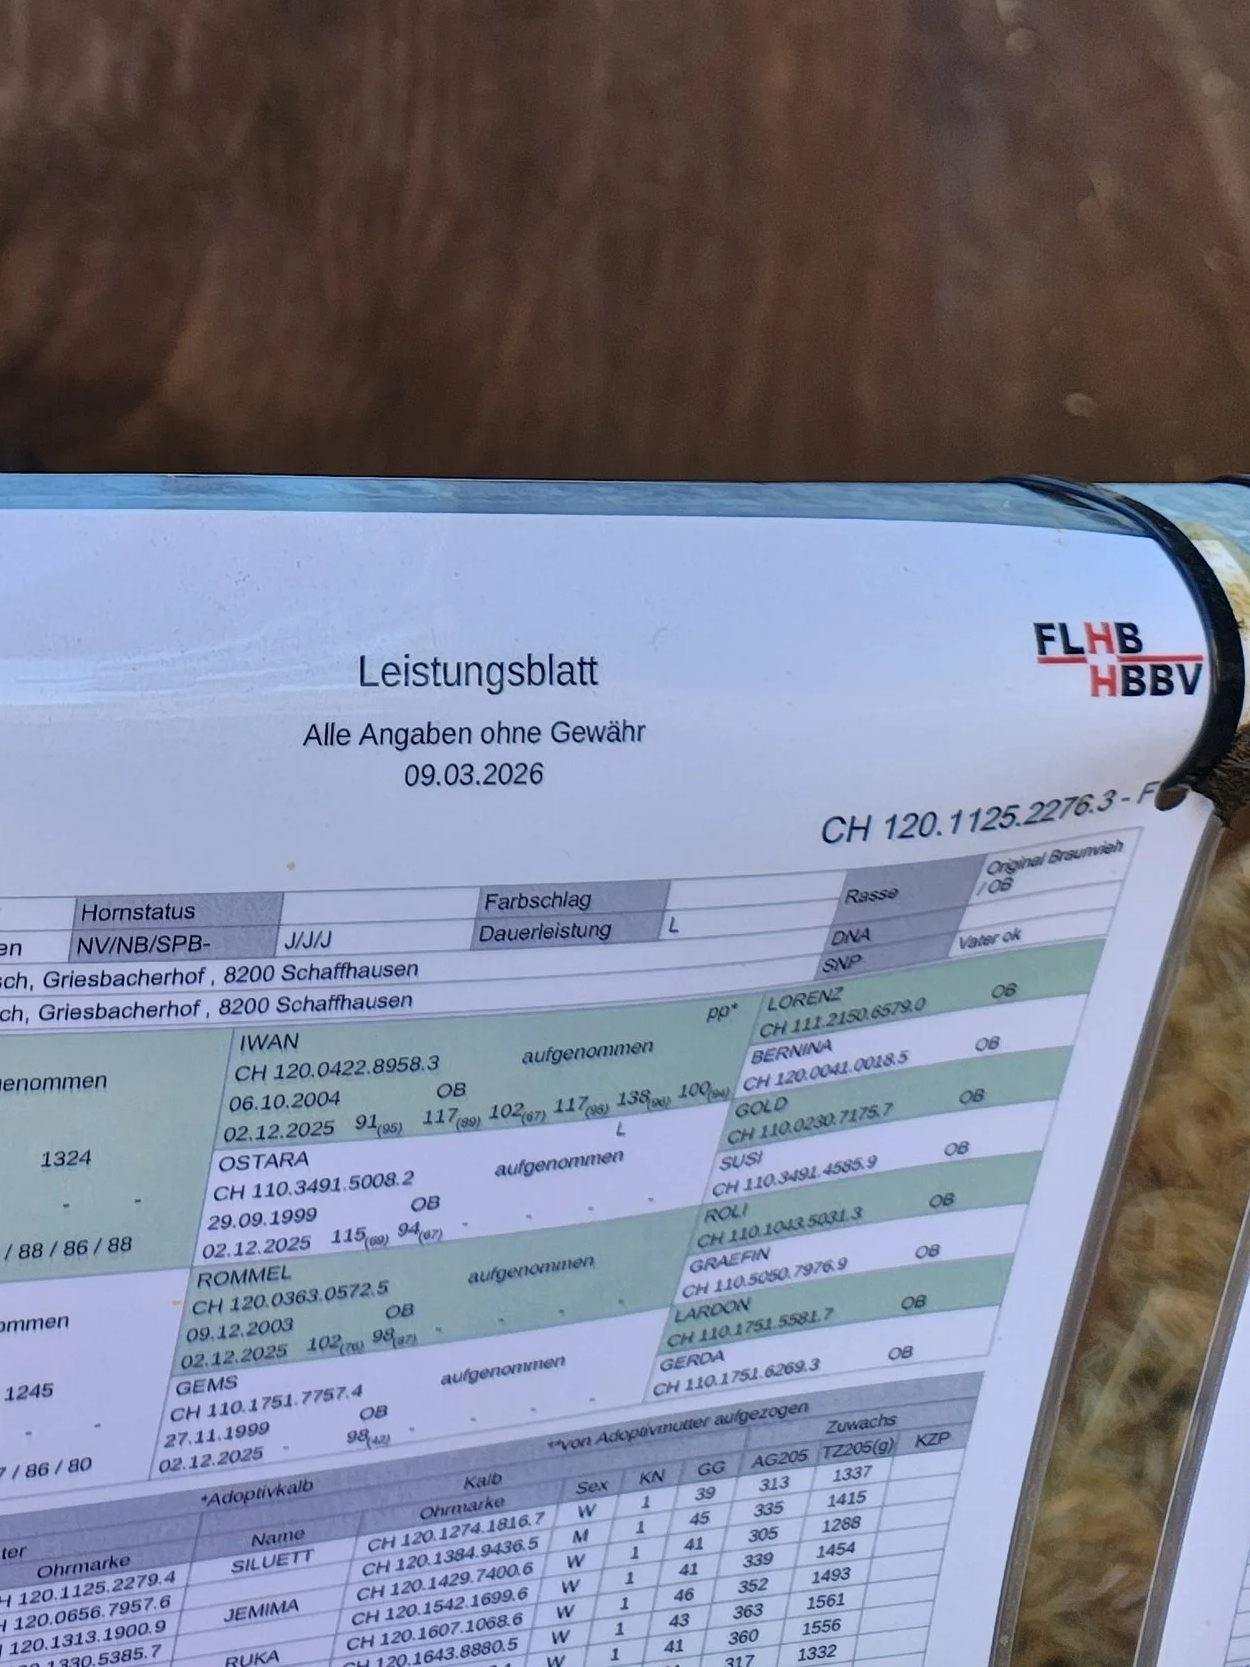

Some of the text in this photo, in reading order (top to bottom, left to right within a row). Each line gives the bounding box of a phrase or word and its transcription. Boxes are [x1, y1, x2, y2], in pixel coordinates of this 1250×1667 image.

[1033, 622, 1144, 656] FLHB
[359, 654, 598, 694] Leistungsblatt
[1090, 664, 1203, 697] HBBV
[303, 719, 646, 750] Alle Angaben ohne Gewähr
[405, 762, 543, 787] 09.03.2026
[822, 816, 869, 844] CH
[885, 789, 1116, 839] 120.1125.2276.3
[986, 840, 1124, 876] Original Braunvieh
[845, 887, 898, 904] Rasse
[988, 877, 1014, 894] OB
[82, 903, 195, 922] Hornstatus
[485, 892, 592, 914] Farbschlag
[479, 921, 613, 942] Dauerleistung
[669, 917, 678, 934] L
[77, 935, 210, 956] NV/NB/SPB-
[284, 932, 332, 951] J/J/J
[831, 928, 870, 947] DNA
[959, 927, 1021, 950] Vater ok
[43, 967, 205, 988] Griesbacherhof
[224, 965, 274, 984] 8200
[281, 961, 418, 981] Schaffhausen
[823, 954, 862, 973] SNP
[767, 986, 845, 1011] LORENZ
[991, 983, 1018, 999] OB
[39, 1000, 200, 1020] Griesbacherhof
[219, 997, 269, 1015] 8200
[276, 992, 413, 1013] Schaffhausen
[240, 1033, 299, 1051] IWAN
[522, 1038, 653, 1066] aufgenommen
[750, 1038, 832, 1064] BERNINA
[974, 1037, 1001, 1052] OB
[235, 1056, 440, 1082] CH 120.0422.8958.3
[437, 1082, 467, 1099] OB
[742, 1075, 771, 1092] CH
[229, 1092, 340, 1112] 06.10.2004
[735, 1097, 789, 1119] GOLD
[224, 1121, 335, 1143] 02.12.2025
[41, 1150, 91, 1168] 1324
[219, 1151, 309, 1172] OSTARA
[495, 1148, 624, 1177] aufgenommen
[719, 1151, 763, 1171] SUSI
[213, 1170, 415, 1202] CH 110.3491.5008.2
[411, 1195, 441, 1212] OB
[208, 1207, 318, 1231] 29.09.1999
[689, 1247, 771, 1273] GRAEFIN
[197, 1265, 292, 1289] ROMMEL
[192, 1280, 390, 1316] CH 120.0363.0572.5
[674, 1298, 751, 1323] LARDON
[659, 1350, 724, 1372] GERDA
[887, 1345, 914, 1361] OB
[4, 1382, 54, 1402] 1245
[176, 1375, 238, 1396] GEMS
[653, 1380, 681, 1397] CH
[170, 1383, 363, 1423] CH 110.1751.7757.4
[715, 1400, 809, 1426] aufgezogen
[164, 1421, 270, 1448] 27.11.1999
[825, 1413, 897, 1435] Zuwachs
[823, 1438, 895, 1460] TZ205(g)
[914, 1431, 951, 1449] KZP
[697, 1460, 726, 1477] GG
[751, 1449, 809, 1467] AG205
[463, 1473, 502, 1490] Kalb
[639, 1469, 666, 1486] KN
[758, 1475, 790, 1492] 313
[832, 1465, 873, 1483] 1337
[575, 1478, 608, 1495] Sex
[695, 1485, 717, 1501] 39
[419, 1496, 506, 1521] Ohrmarke
[251, 1528, 305, 1548] Name
[368, 1511, 545, 1553] CH 120.1274.1816.7
[36, 1555, 131, 1578] Ohrmarke
[231, 1549, 315, 1574] SILUETT
[17, 1571, 176, 1605] 120.1125.2279.4
[12, 1595, 171, 1630] 120.0656.7957.6
[224, 1599, 299, 1623] JEMIMA
